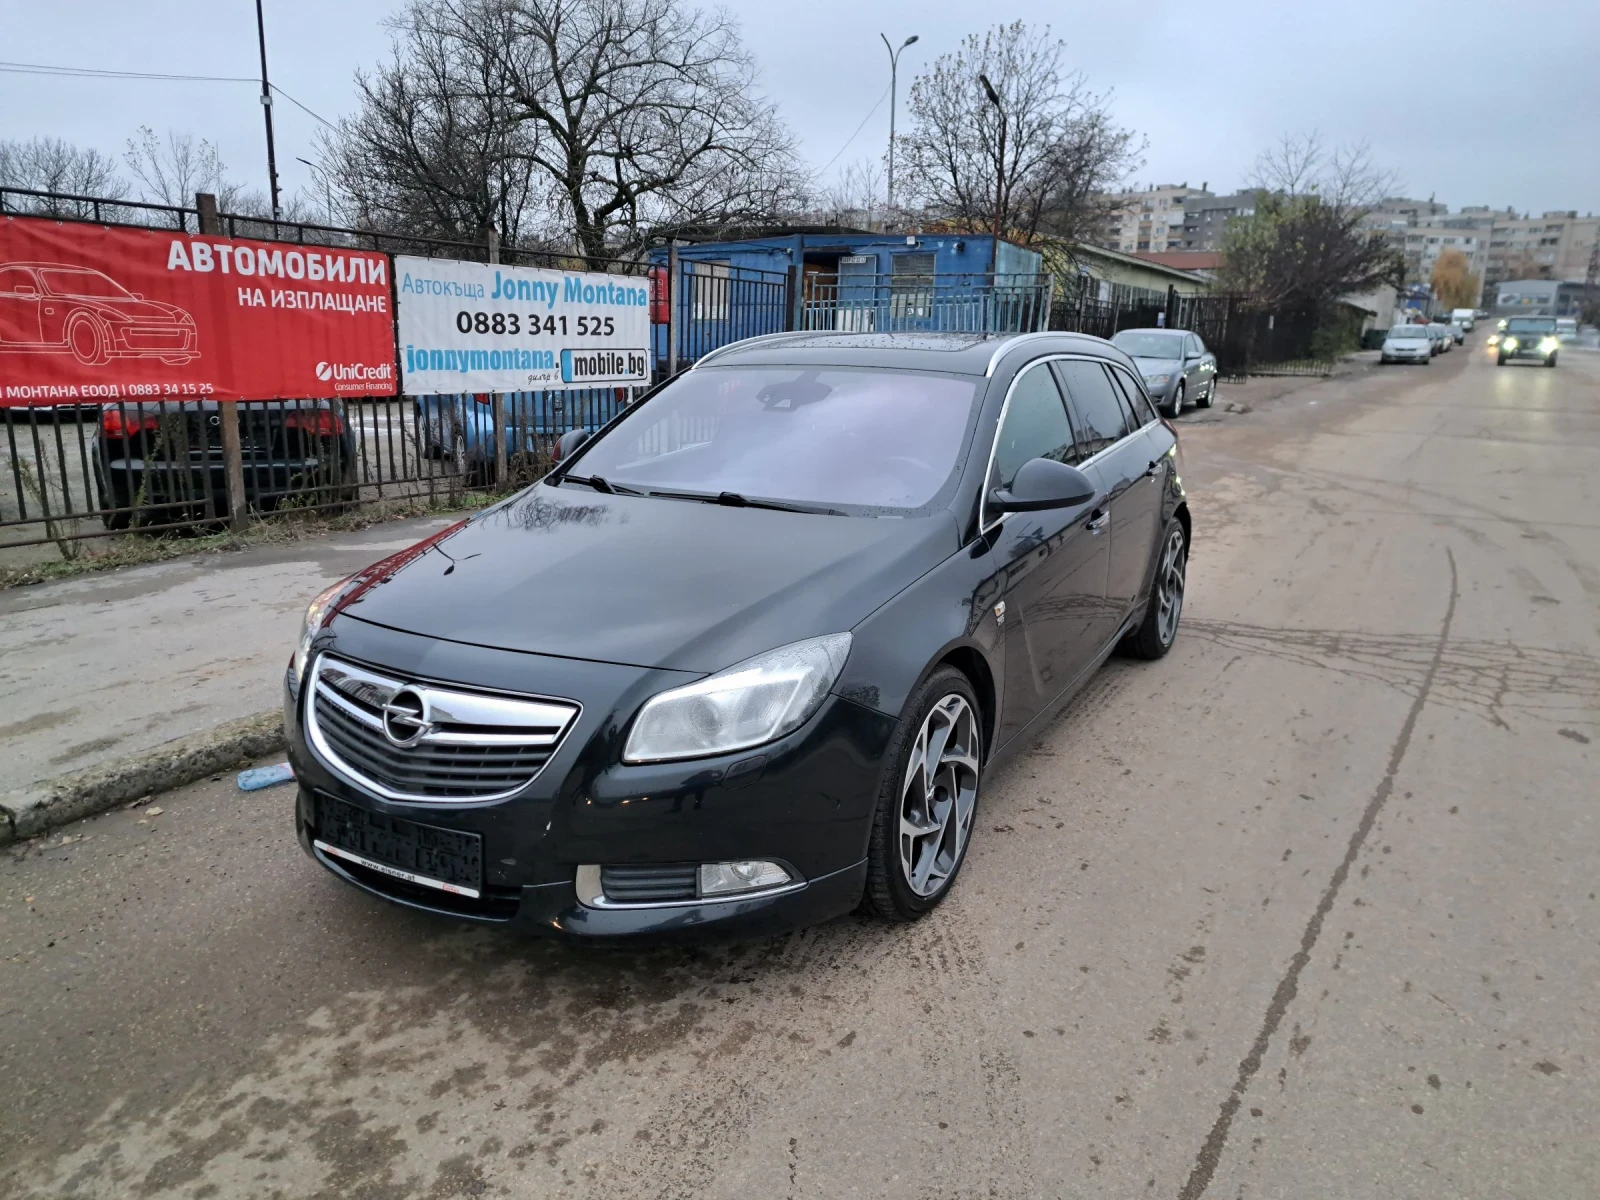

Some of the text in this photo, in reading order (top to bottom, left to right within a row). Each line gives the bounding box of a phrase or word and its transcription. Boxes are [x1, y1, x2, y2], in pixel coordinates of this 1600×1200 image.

[167, 240, 386, 285] АВТОМОБИЛИ
[237, 287, 387, 315] НА ИЗПЛАЩАНЕ
[402, 272, 484, 301] Автокъща
[491, 271, 558, 310] Jonny
[563, 276, 647, 307] Montana
[456, 311, 615, 336] 0883 341 525
[333, 363, 391, 380] UniCredit
[574, 351, 645, 378] mobile.bg
[6, 385, 79, 399] МОНТАНА
[82, 384, 120, 398] ЕООД
[129, 384, 161, 396] 0883
[163, 384, 179, 395] 34
[182, 383, 197, 395] 15
[199, 383, 214, 394] 25
[334, 381, 393, 391] Consumer Financing
[360, 858, 416, 882] www.eisner.at
